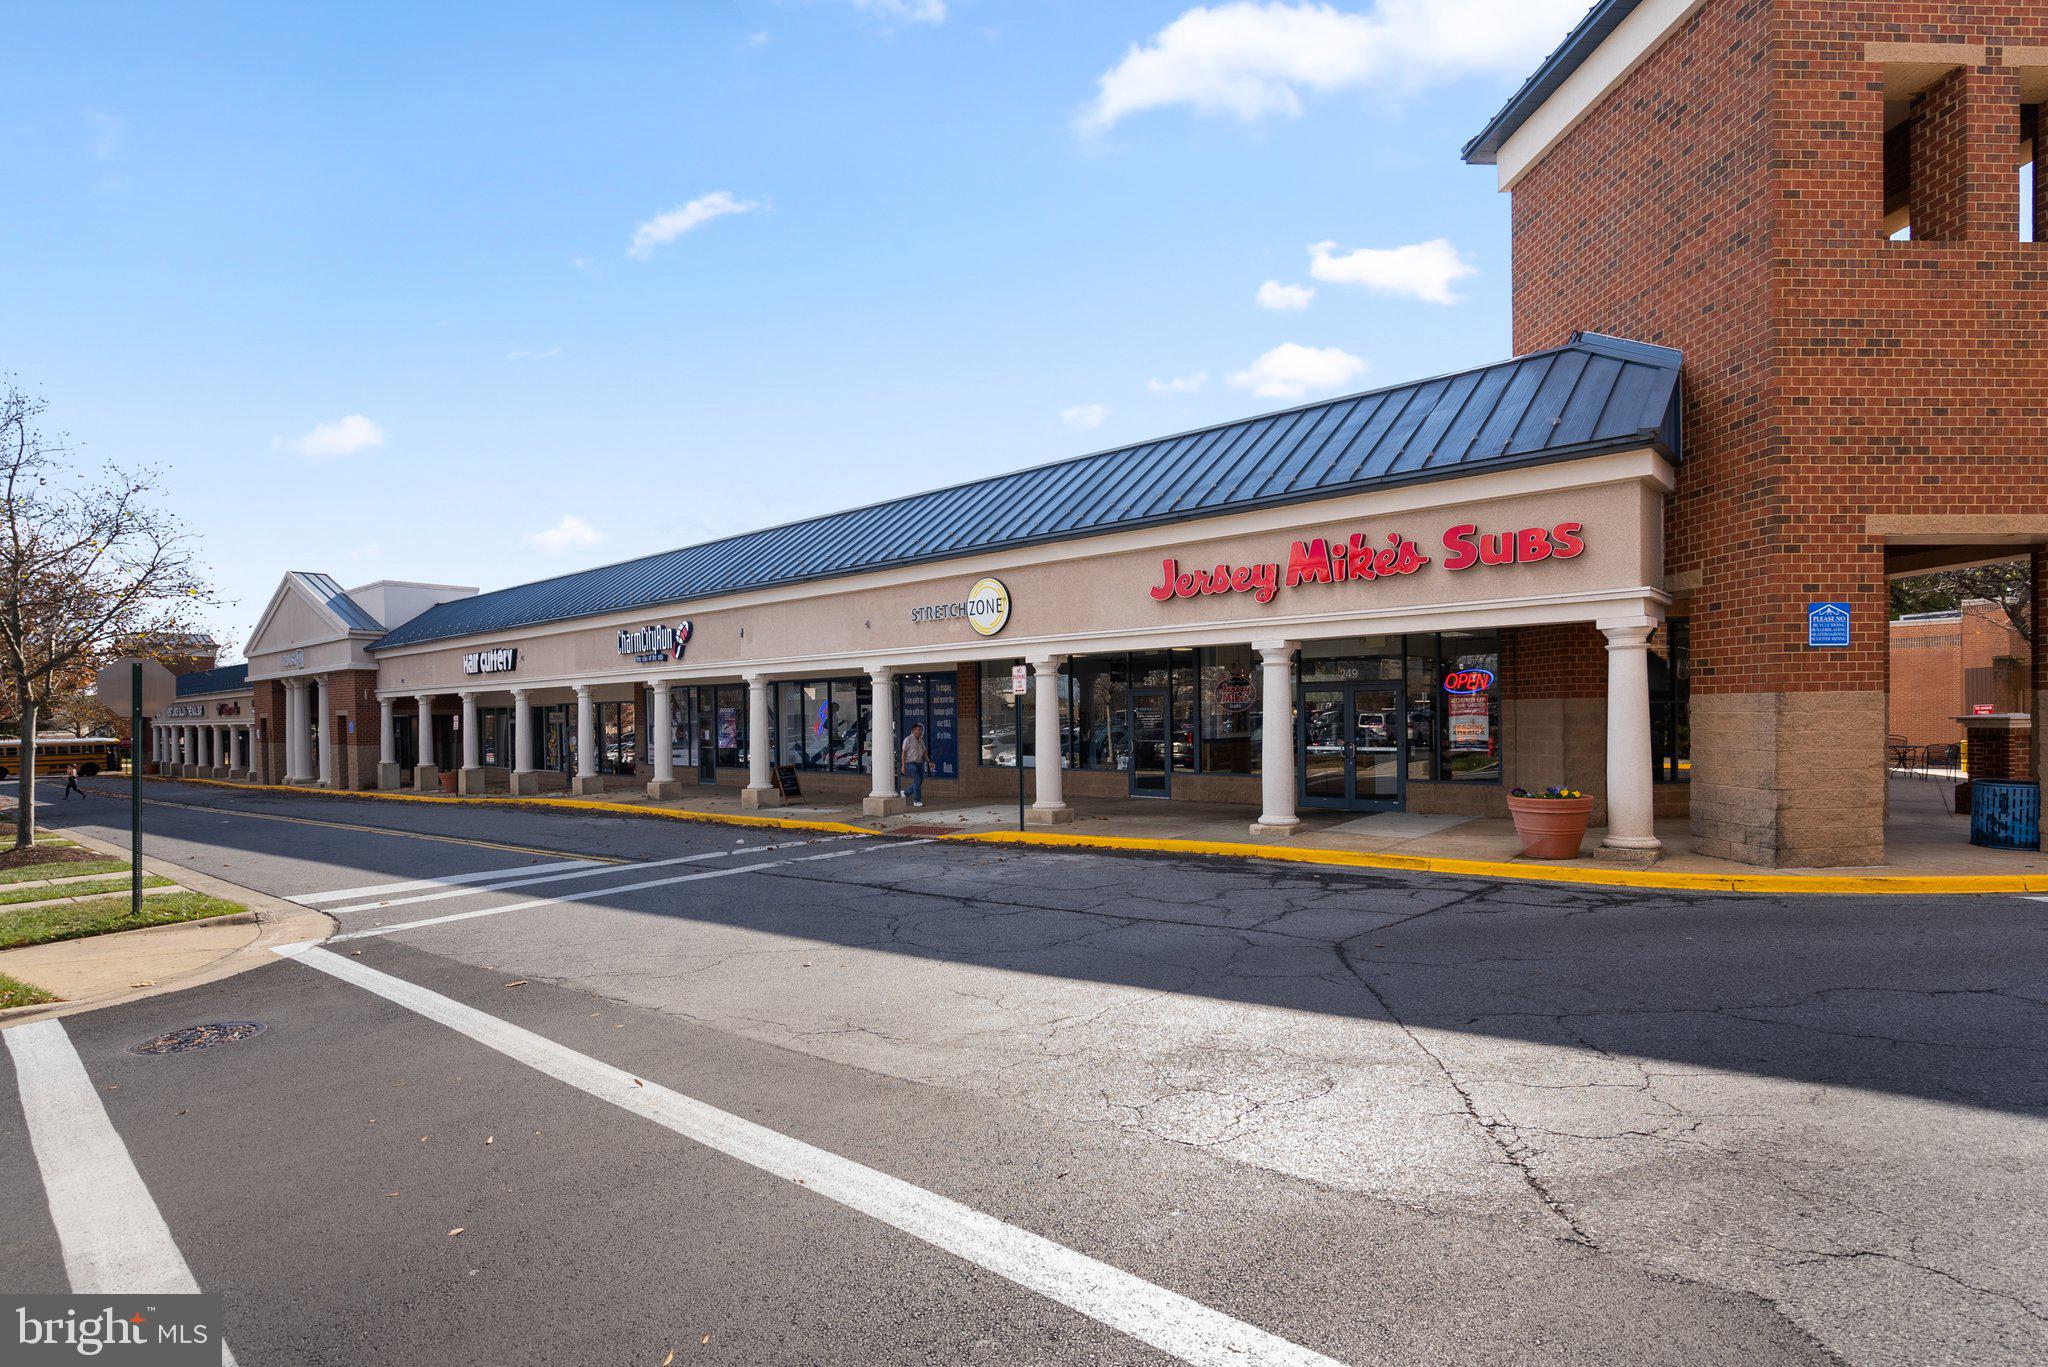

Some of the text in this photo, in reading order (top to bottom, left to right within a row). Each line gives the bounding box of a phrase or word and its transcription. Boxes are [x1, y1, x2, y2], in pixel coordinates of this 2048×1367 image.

[1149, 522, 1585, 603] Jersey Mike's SUBS
[911, 597, 1004, 622] STRETCH ZONE
[463, 652, 480, 674] Hair
[1143, 677, 1156, 686] 251
[1341, 668, 1358, 679] 249
[1445, 672, 1490, 690] OPEN
